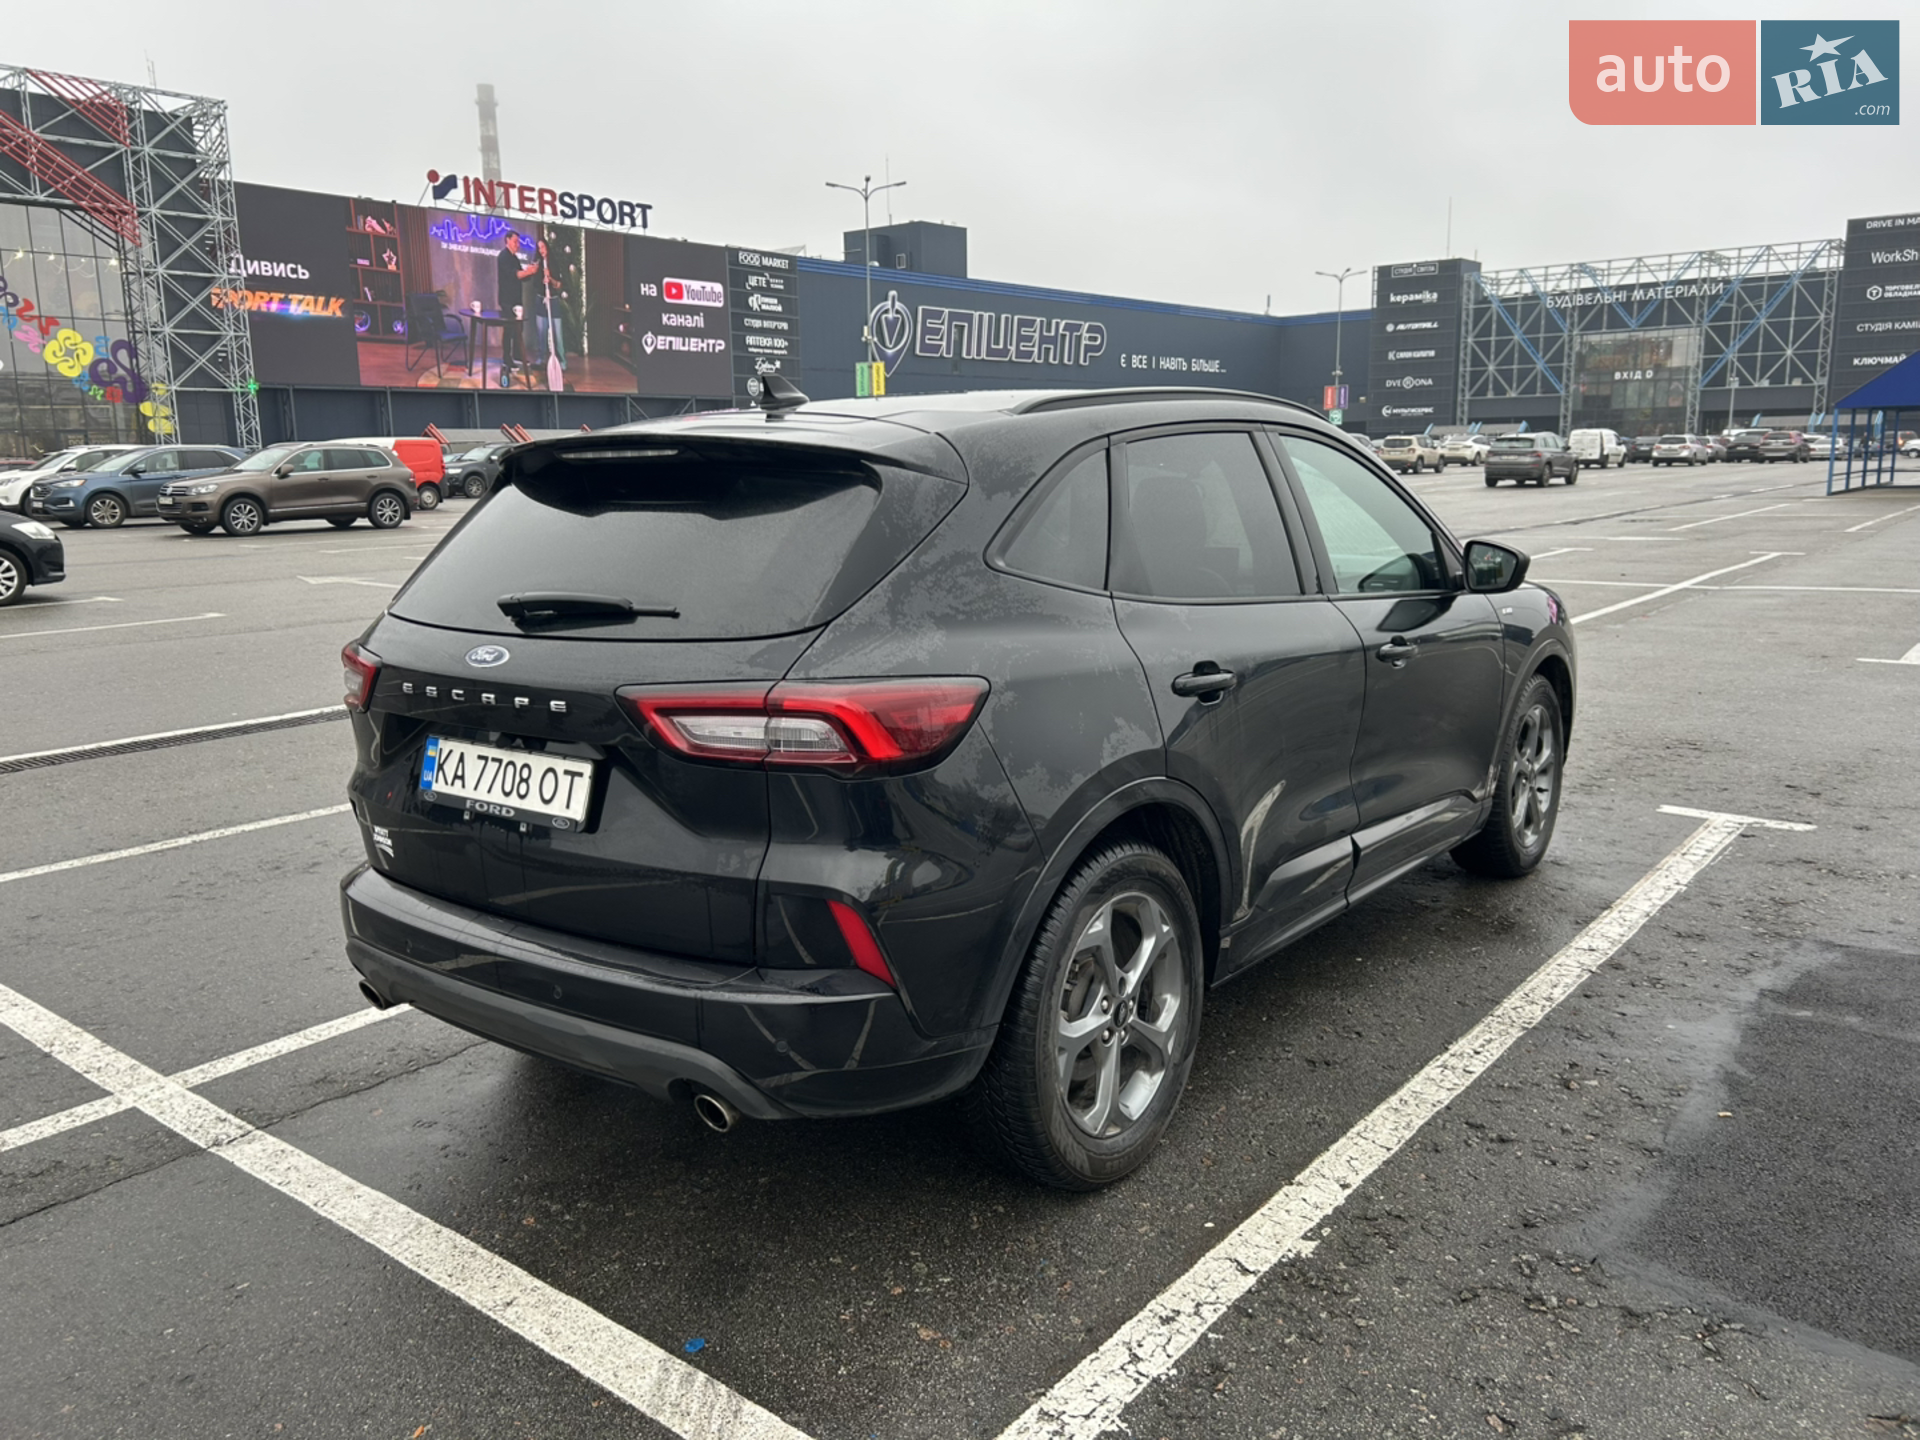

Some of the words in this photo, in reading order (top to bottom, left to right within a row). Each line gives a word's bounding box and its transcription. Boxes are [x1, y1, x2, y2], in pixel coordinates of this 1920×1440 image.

[463, 176, 653, 229] INTERSPORT
[1866, 219, 1893, 229] DRIVE
[1894, 218, 1905, 227] IN
[229, 253, 310, 280] Дивись
[739, 251, 761, 267] FOOD
[762, 256, 789, 269] MARKET
[640, 283, 658, 297] на
[684, 284, 723, 304] YouTube
[1545, 290, 1627, 309] БУДІВЕЛЬНІ
[1631, 283, 1724, 302] МАТЕРІАЛИ
[288, 294, 345, 317] TALK
[661, 312, 705, 328] каналі
[1856, 322, 1893, 332] СТУДІЯ
[656, 335, 726, 353] ЕПІЦЕНТР
[745, 335, 772, 347] АПТЕКА
[915, 305, 1107, 366] ЕПІЦЕНТР
[1120, 353, 1127, 368] Є
[1131, 354, 1148, 369] ВСЕ
[1159, 356, 1188, 371] НАВІТЬ
[1614, 370, 1642, 380] ВХІД
[402, 681, 567, 713] ESCAPE
[473, 754, 533, 800] 7708
[466, 799, 515, 818] FORD
